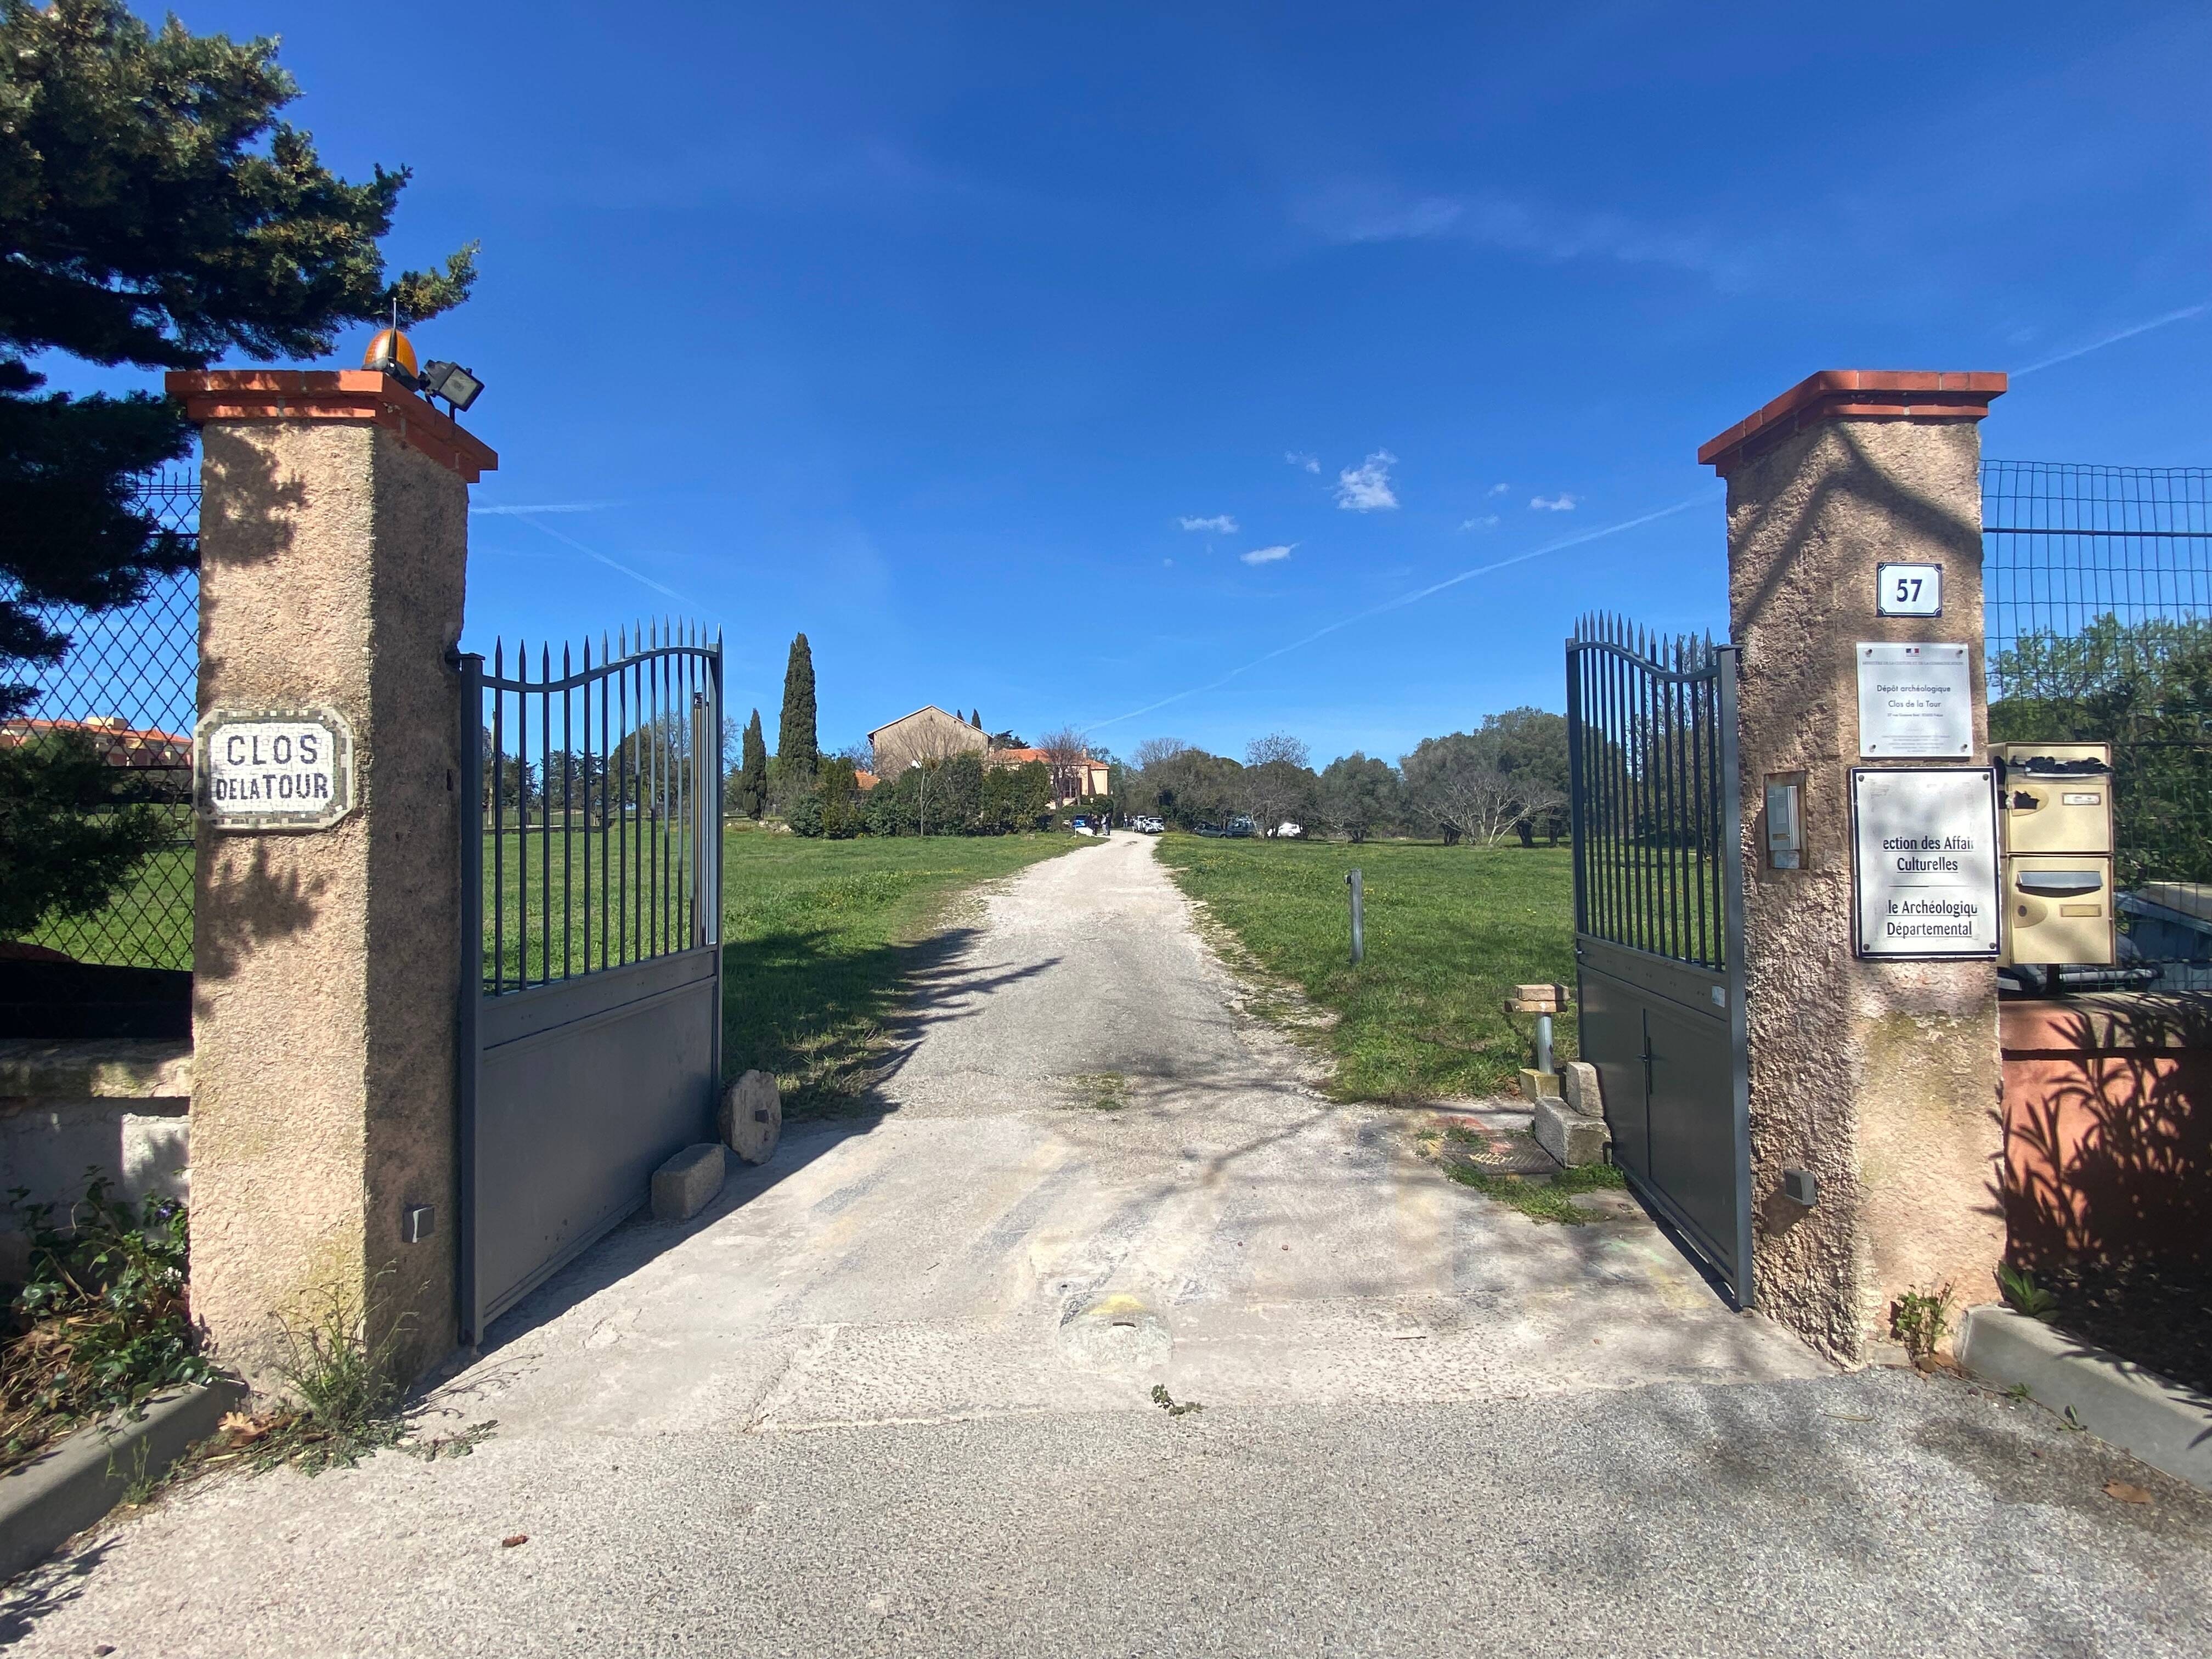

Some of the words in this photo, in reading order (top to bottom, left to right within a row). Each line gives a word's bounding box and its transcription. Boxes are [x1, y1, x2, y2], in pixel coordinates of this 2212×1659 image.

[1897, 579, 1922, 602] 57
[1877, 685, 1898, 693] Dépôt
[1900, 684, 1951, 694] archéologique
[227, 734, 319, 766] CLOS
[1921, 835, 1940, 849] des
[1897, 856, 1958, 871] Culturelles
[1887, 921, 1972, 939] Départemental
